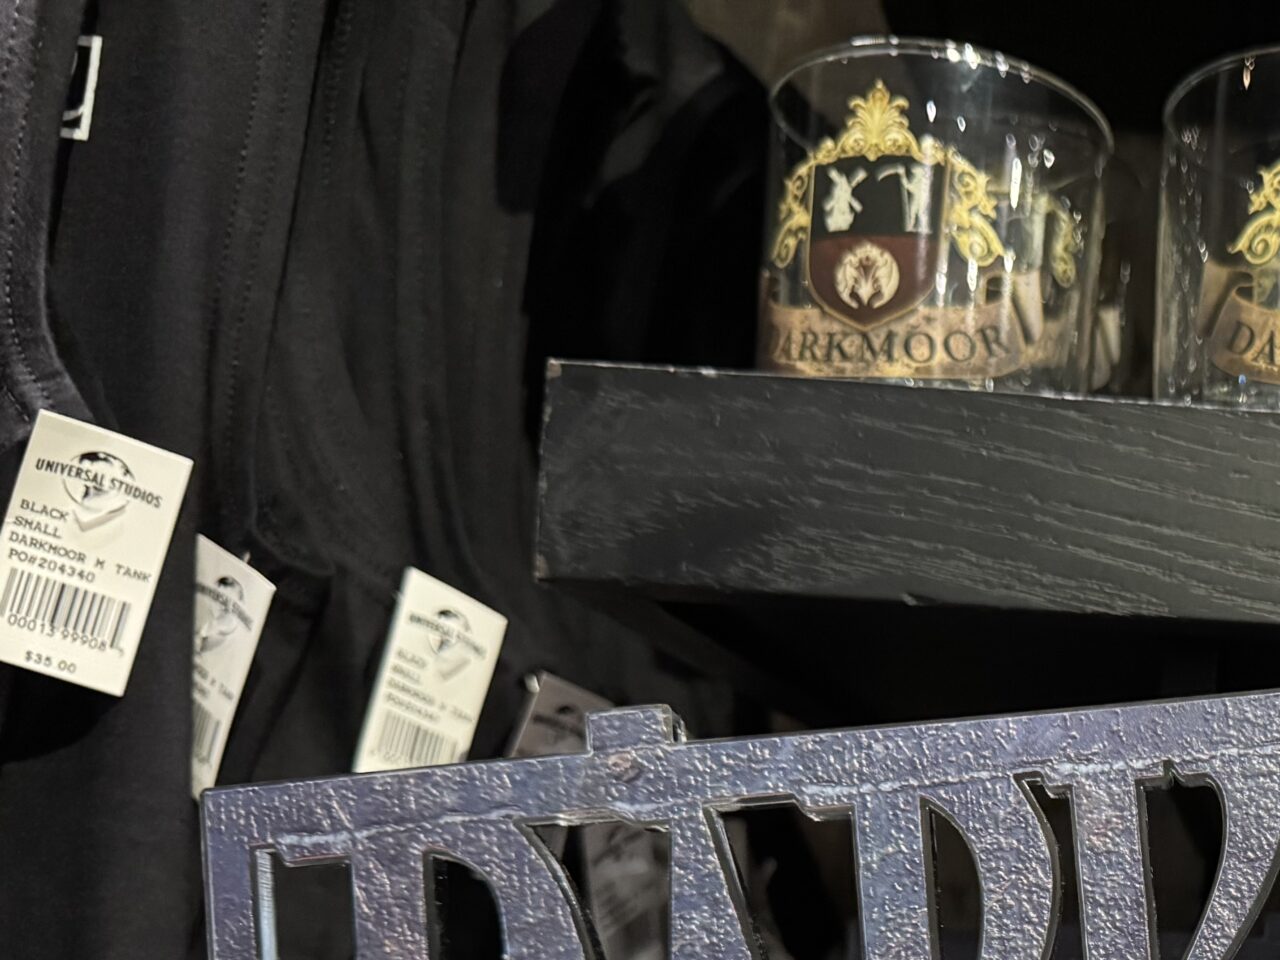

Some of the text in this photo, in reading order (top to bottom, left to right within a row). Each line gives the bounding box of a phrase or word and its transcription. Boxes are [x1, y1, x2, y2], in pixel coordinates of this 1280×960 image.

[35, 457, 162, 509] UNIVERSAL STUDIOS
[20, 499, 69, 521] BLACK
[13, 516, 62, 539] SMALL
[8, 549, 95, 583] PO#204340
[9, 532, 87, 563] DARKMOOR
[115, 563, 152, 583] TANK
